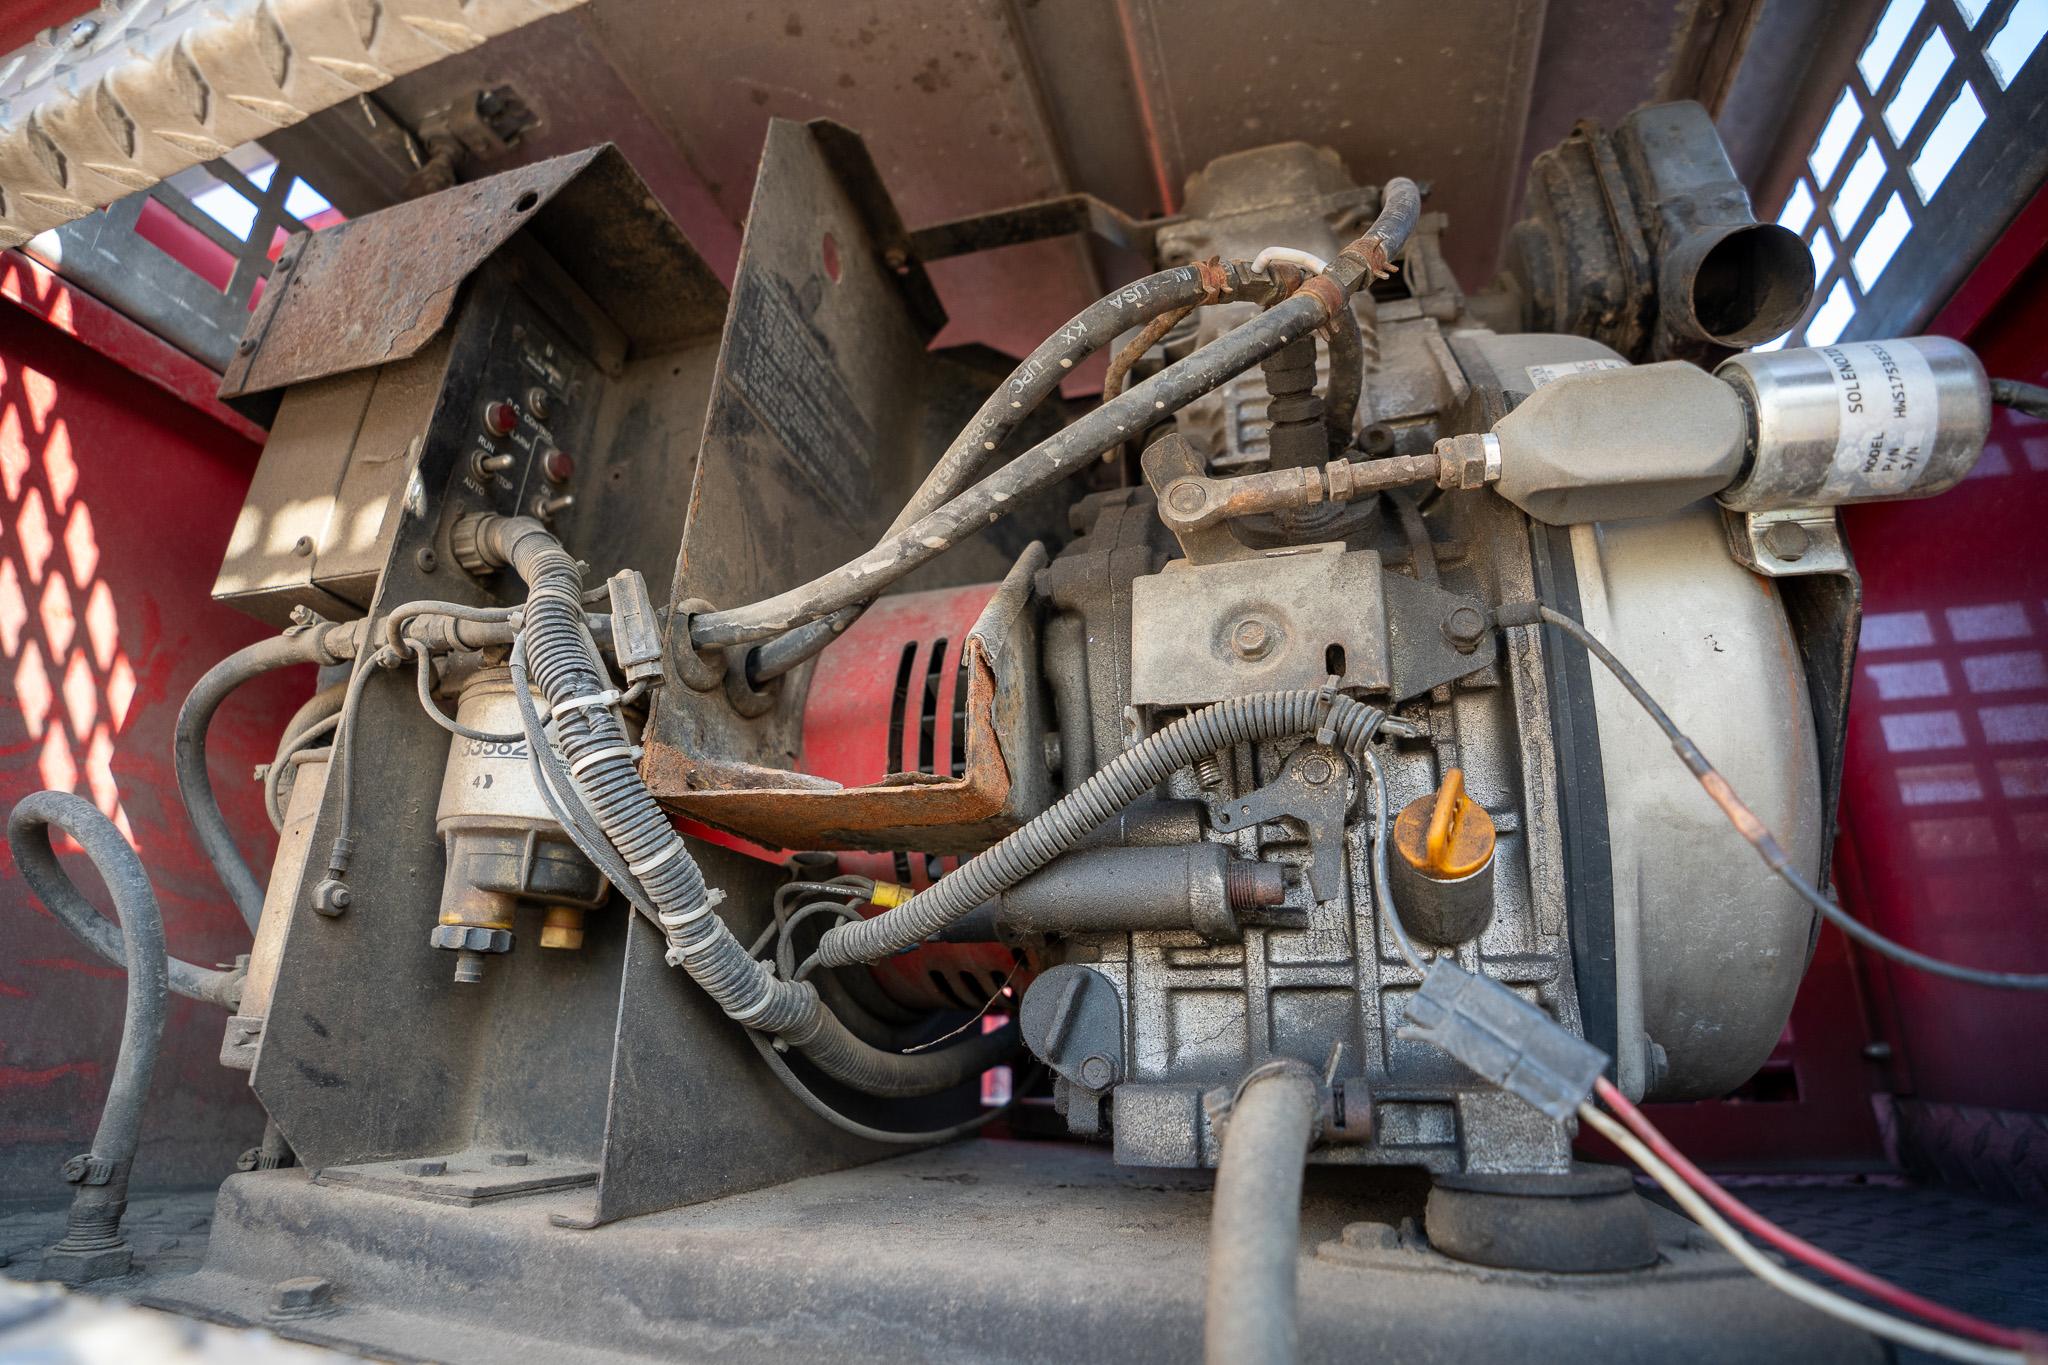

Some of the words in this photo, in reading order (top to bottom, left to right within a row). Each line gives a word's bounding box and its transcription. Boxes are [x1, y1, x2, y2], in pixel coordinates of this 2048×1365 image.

[1108, 282, 1150, 310] USA
[1009, 360, 1044, 394] UPC
[1823, 347, 1863, 414] SOLENOID
[478, 435, 496, 454] RUN
[1863, 431, 1885, 473] MODEL
[1882, 447, 1901, 472] P/N
[1901, 446, 1920, 471] S/N
[463, 475, 485, 497] AUTO
[472, 775, 481, 789] 4
